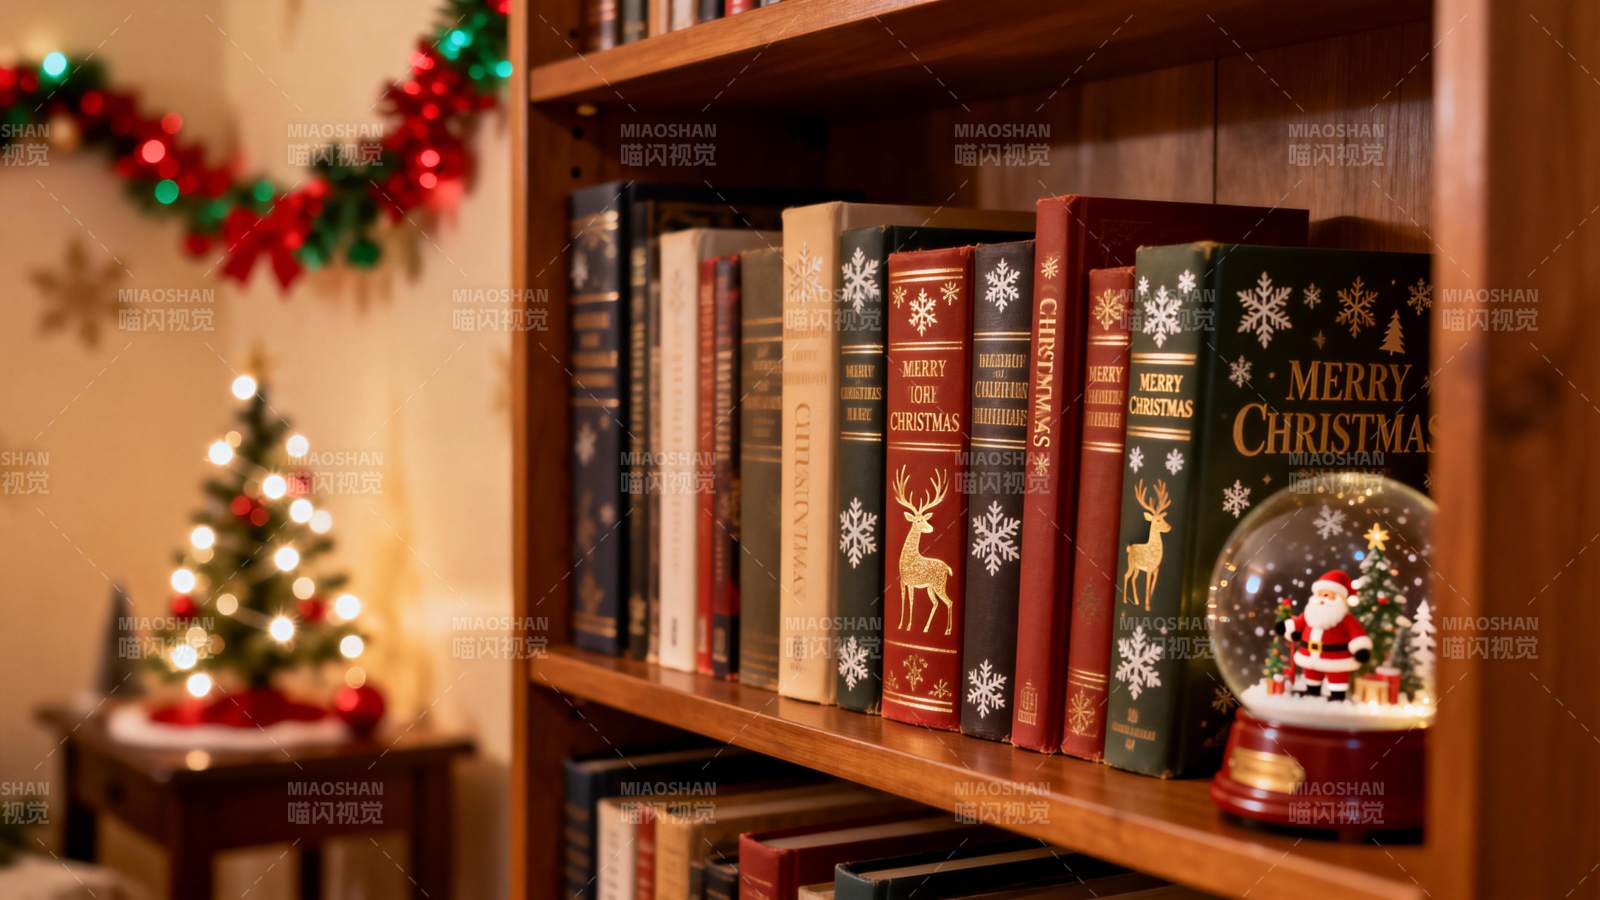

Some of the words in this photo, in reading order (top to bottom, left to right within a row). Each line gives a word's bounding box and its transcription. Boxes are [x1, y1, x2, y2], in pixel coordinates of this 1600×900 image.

[902, 360, 946, 378] MERRY
[1089, 366, 1124, 383] MERRY
[1139, 373, 1183, 393] MERRY
[1286, 360, 1412, 401] MERRY
[1129, 396, 1194, 418] CHRISTMAS
[890, 412, 960, 432] CHRISTMAS
[1233, 403, 1440, 456] CHRISTMAS
